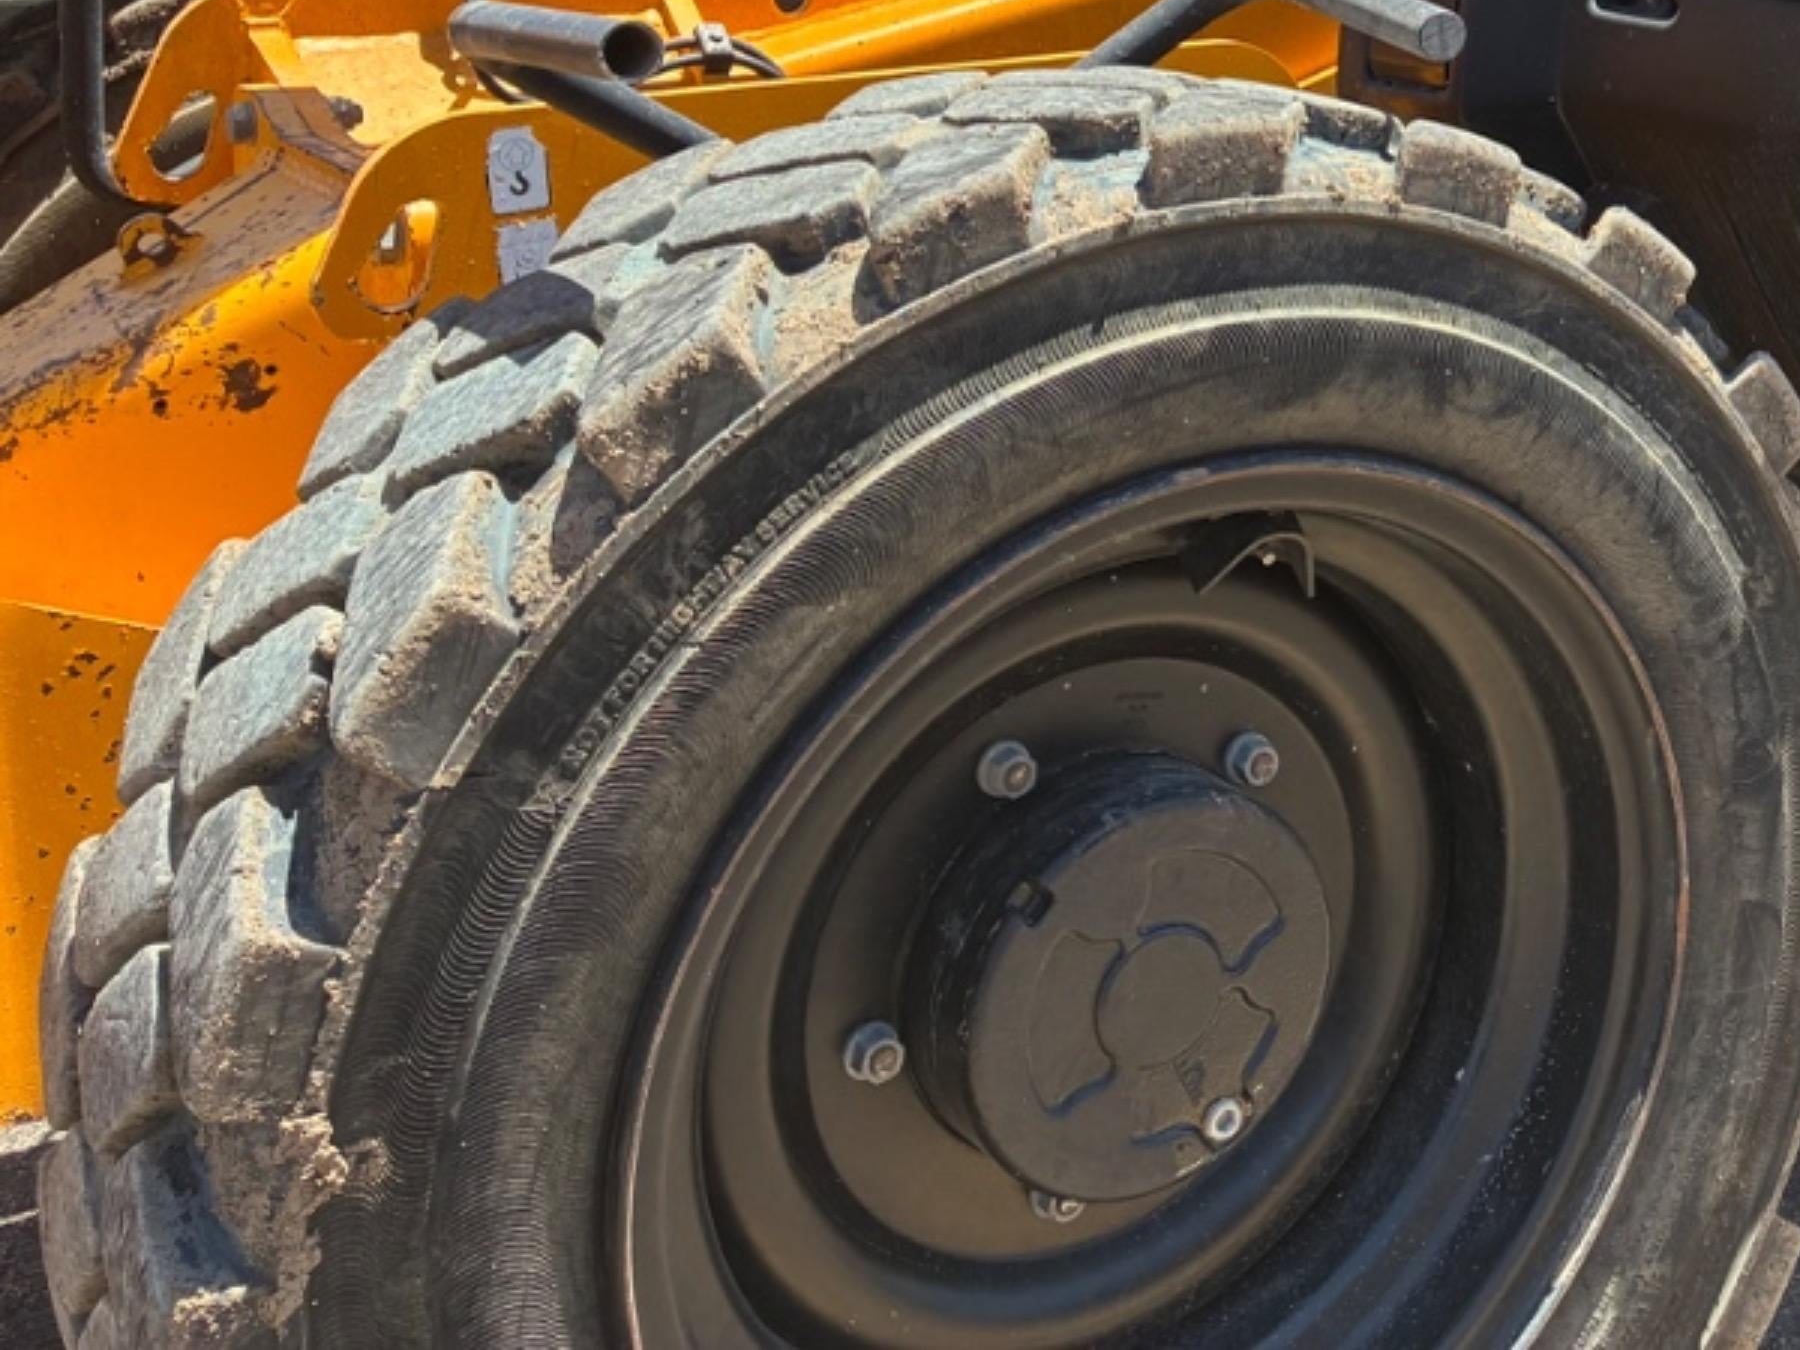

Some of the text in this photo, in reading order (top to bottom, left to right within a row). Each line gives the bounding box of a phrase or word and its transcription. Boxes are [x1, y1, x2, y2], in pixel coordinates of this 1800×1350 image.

[561, 451, 858, 772] NOT FOR HIGHWAY SERVICE
